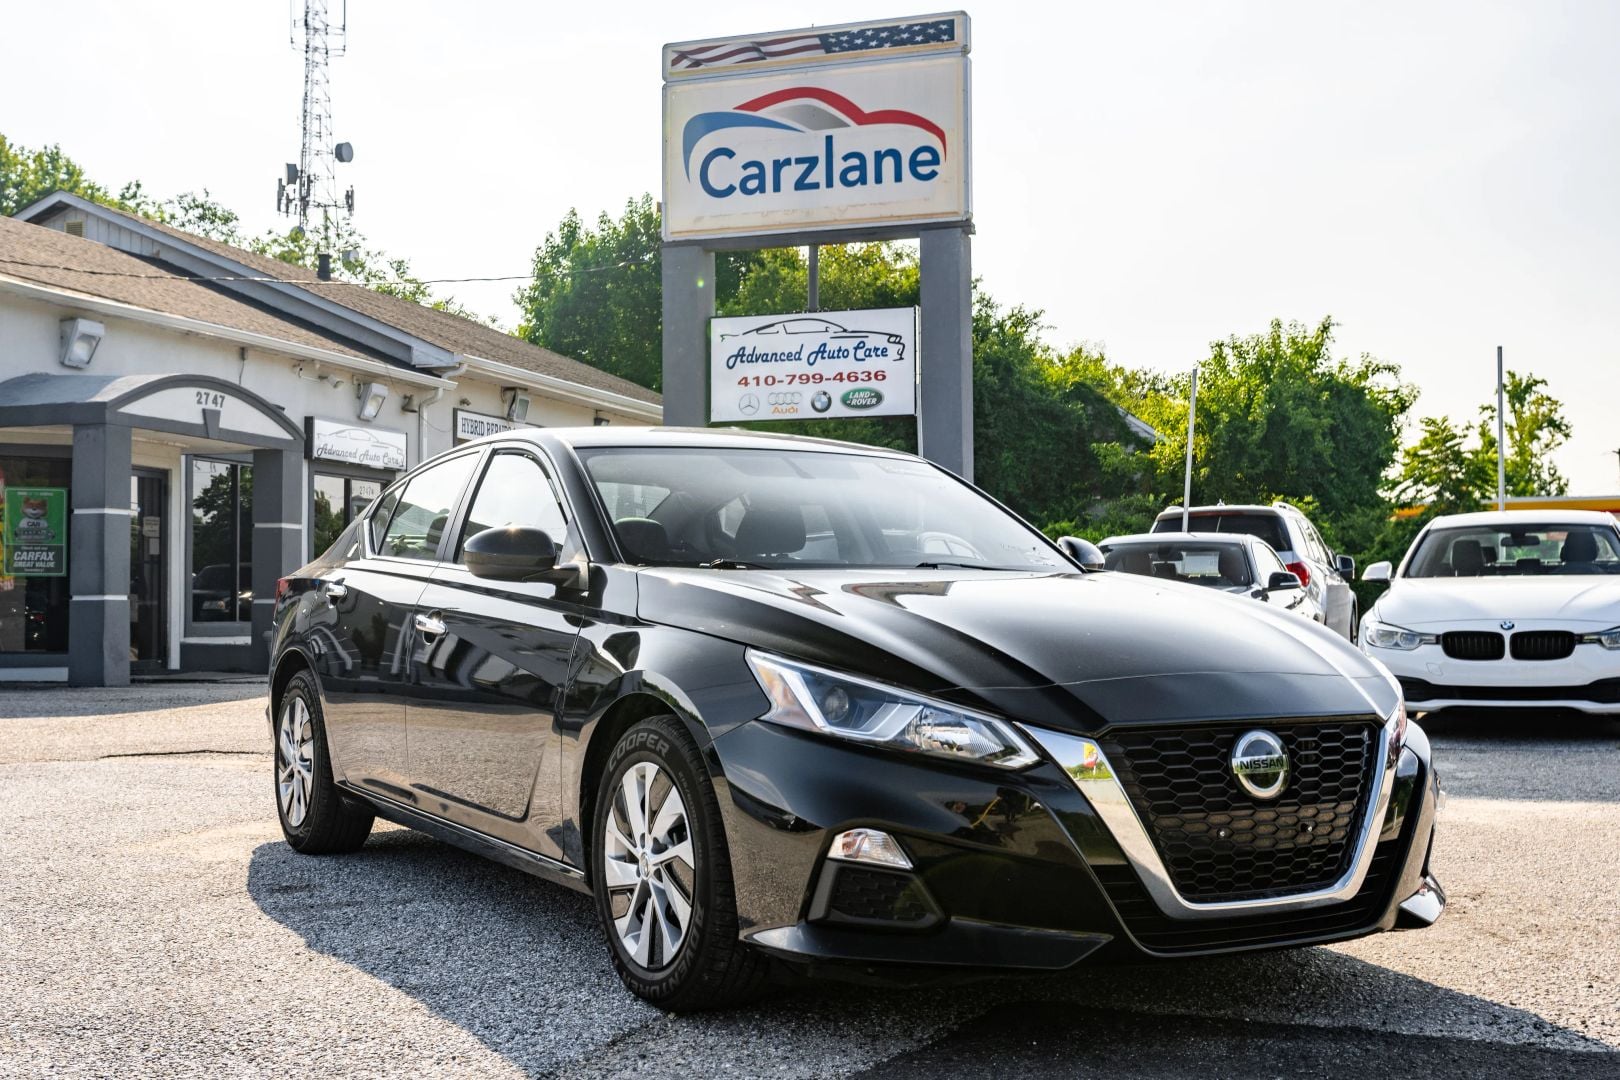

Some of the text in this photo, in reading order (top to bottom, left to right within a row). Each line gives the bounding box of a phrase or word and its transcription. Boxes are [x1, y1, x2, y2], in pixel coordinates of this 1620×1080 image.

[700, 134, 940, 198] Carzlane
[726, 341, 889, 369] Advanced Auto Care
[737, 370, 887, 387] 410-799-4636
[196, 391, 225, 408] 2747
[771, 406, 799, 414] Audi
[461, 417, 485, 436] HYBRID
[316, 443, 358, 458] Advanced
[359, 450, 381, 463] Auto
[13, 551, 55, 561] CARFAX
[609, 732, 670, 772] COOPER
[1240, 759, 1283, 770] NISSAN
